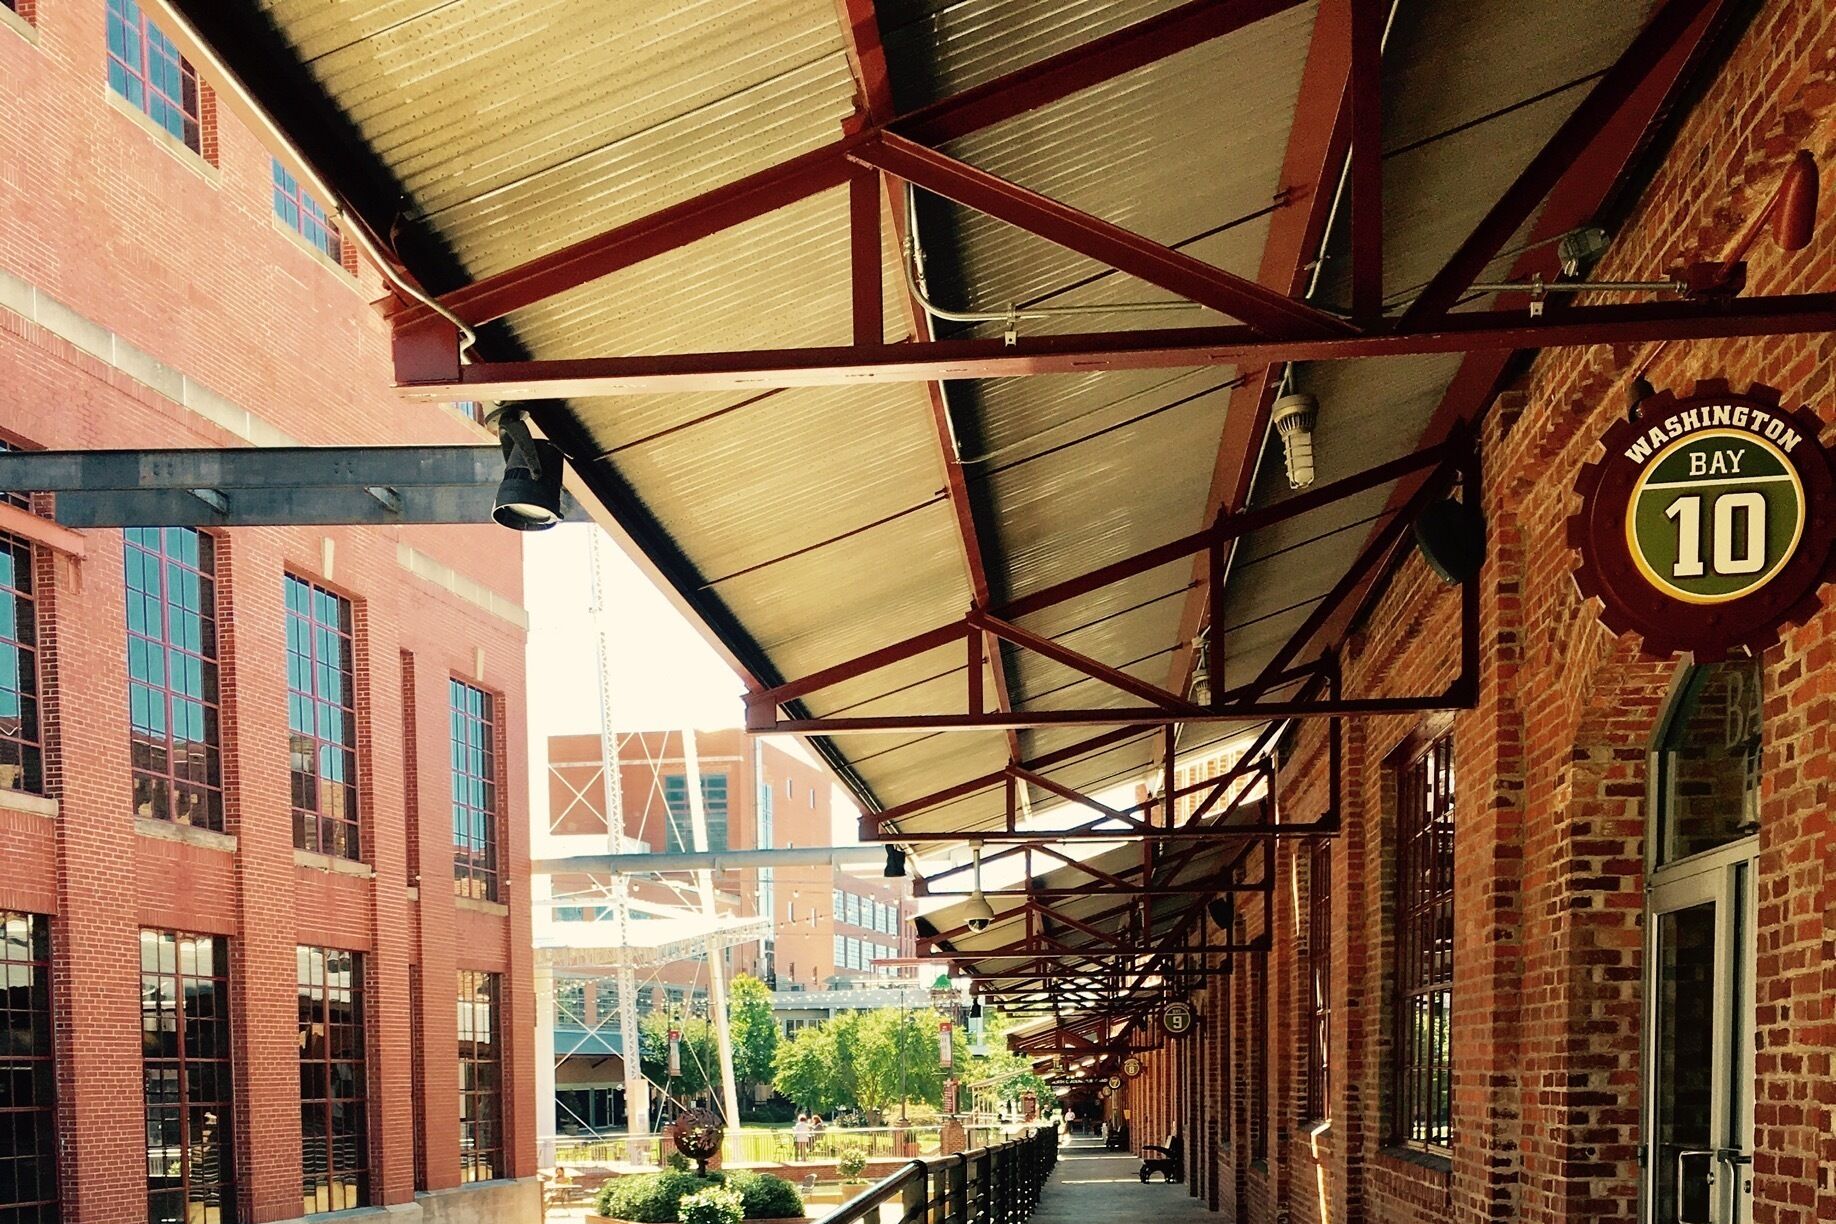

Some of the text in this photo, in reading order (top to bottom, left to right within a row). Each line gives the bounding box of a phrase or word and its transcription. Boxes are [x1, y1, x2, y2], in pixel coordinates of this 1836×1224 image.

[1625, 405, 1802, 465] WASHINGTON
[1689, 449, 1745, 476] BAY
[1665, 492, 1766, 577] 10
[1172, 1015, 1182, 1029] 9
